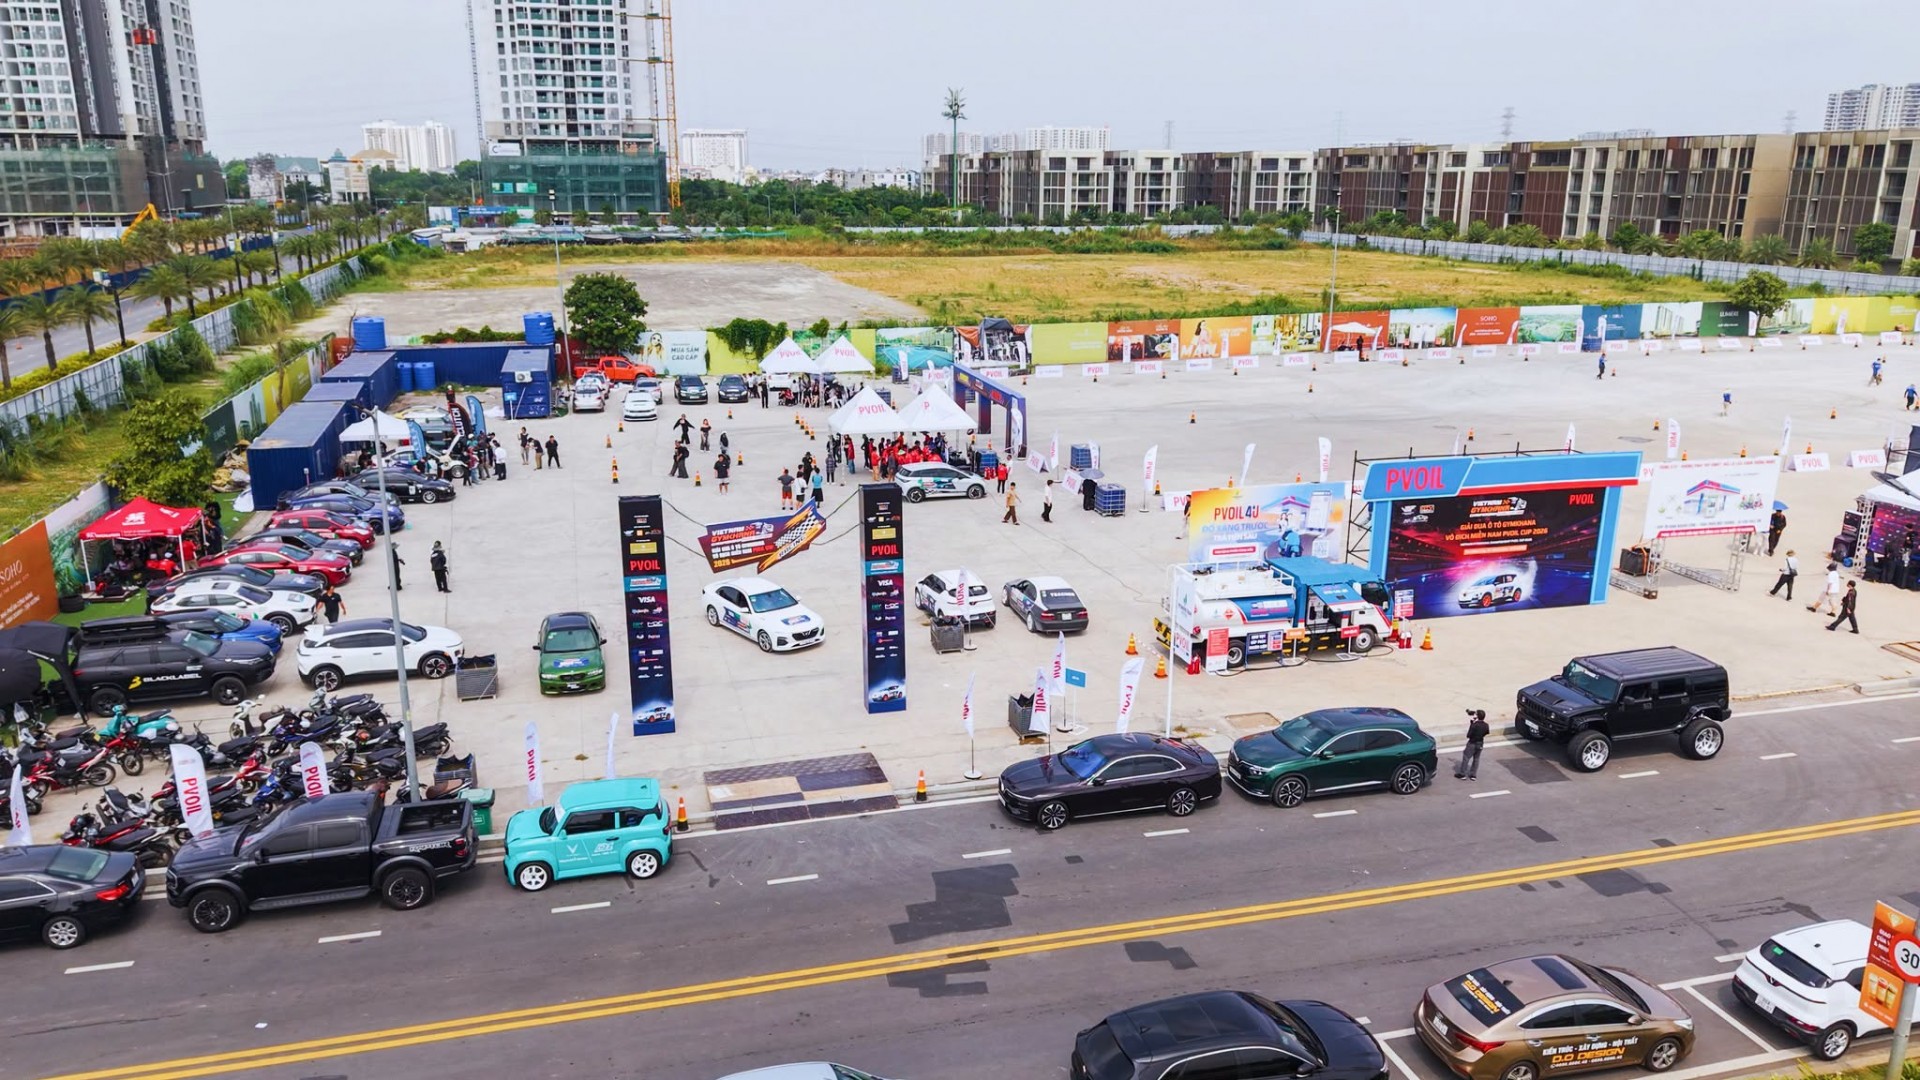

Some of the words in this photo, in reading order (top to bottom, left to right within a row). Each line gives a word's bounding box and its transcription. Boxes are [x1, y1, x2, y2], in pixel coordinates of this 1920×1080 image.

[1802, 459, 1823, 468] PVOIL
[1858, 454, 1879, 464] PVOIL
[1386, 466, 1445, 492] PVOIL
[1569, 494, 1595, 505] PVOIL
[712, 526, 745, 536] VIETNAM
[712, 530, 756, 542] GYMKHANA
[872, 544, 899, 555] PVOIL
[630, 560, 660, 570] PVOIL
[1035, 687, 1046, 712] VOIL
[182, 777, 202, 816] PVOIL
[1900, 948, 1919, 969] 30
[1577, 1047, 1625, 1060] DESIGN
